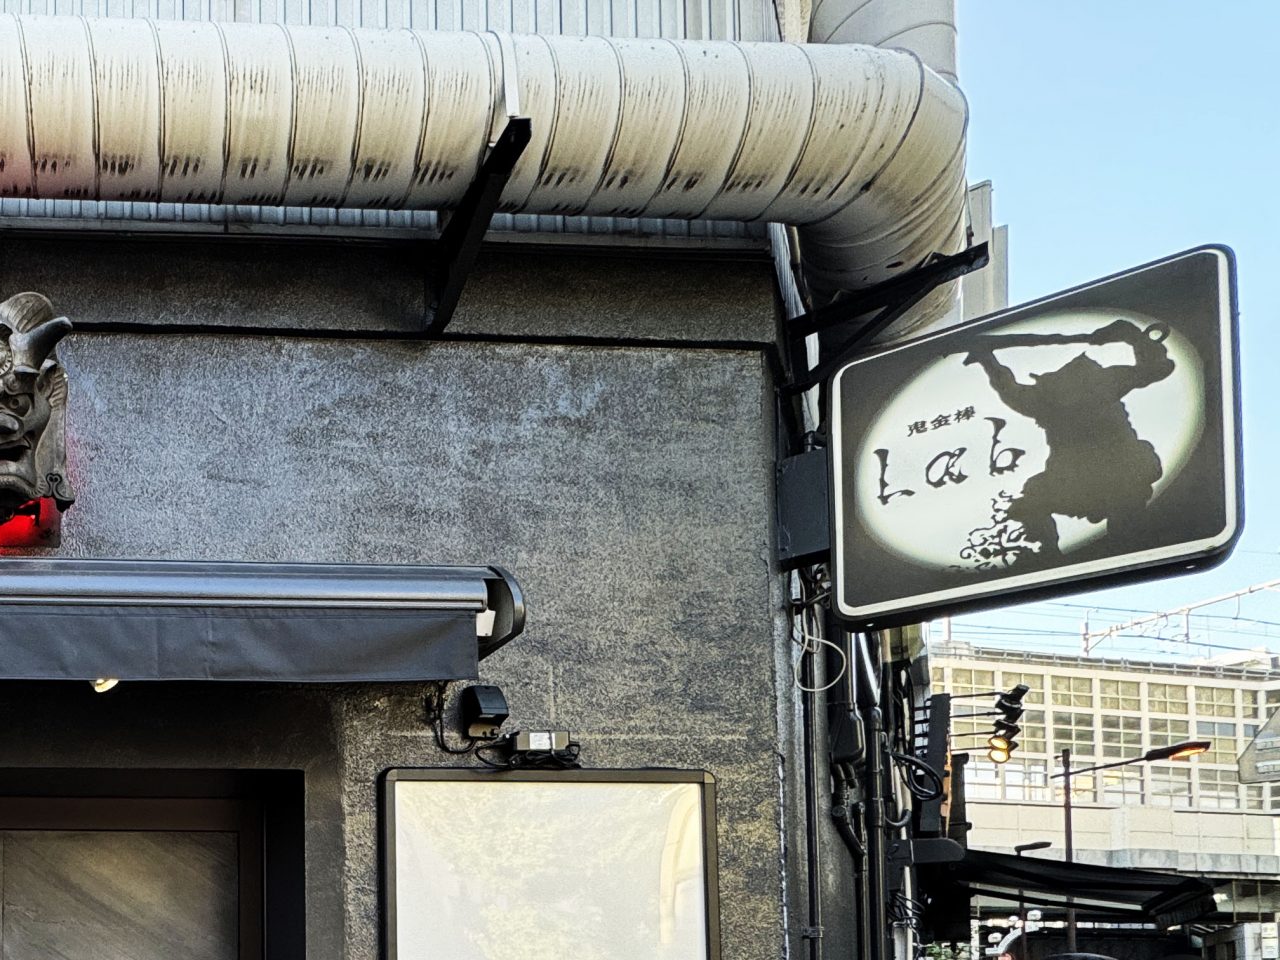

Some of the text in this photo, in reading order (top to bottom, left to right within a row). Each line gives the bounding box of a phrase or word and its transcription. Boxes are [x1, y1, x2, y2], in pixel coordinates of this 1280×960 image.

[907, 405, 977, 437] 鬼金棒
[873, 416, 1026, 506] Lab
